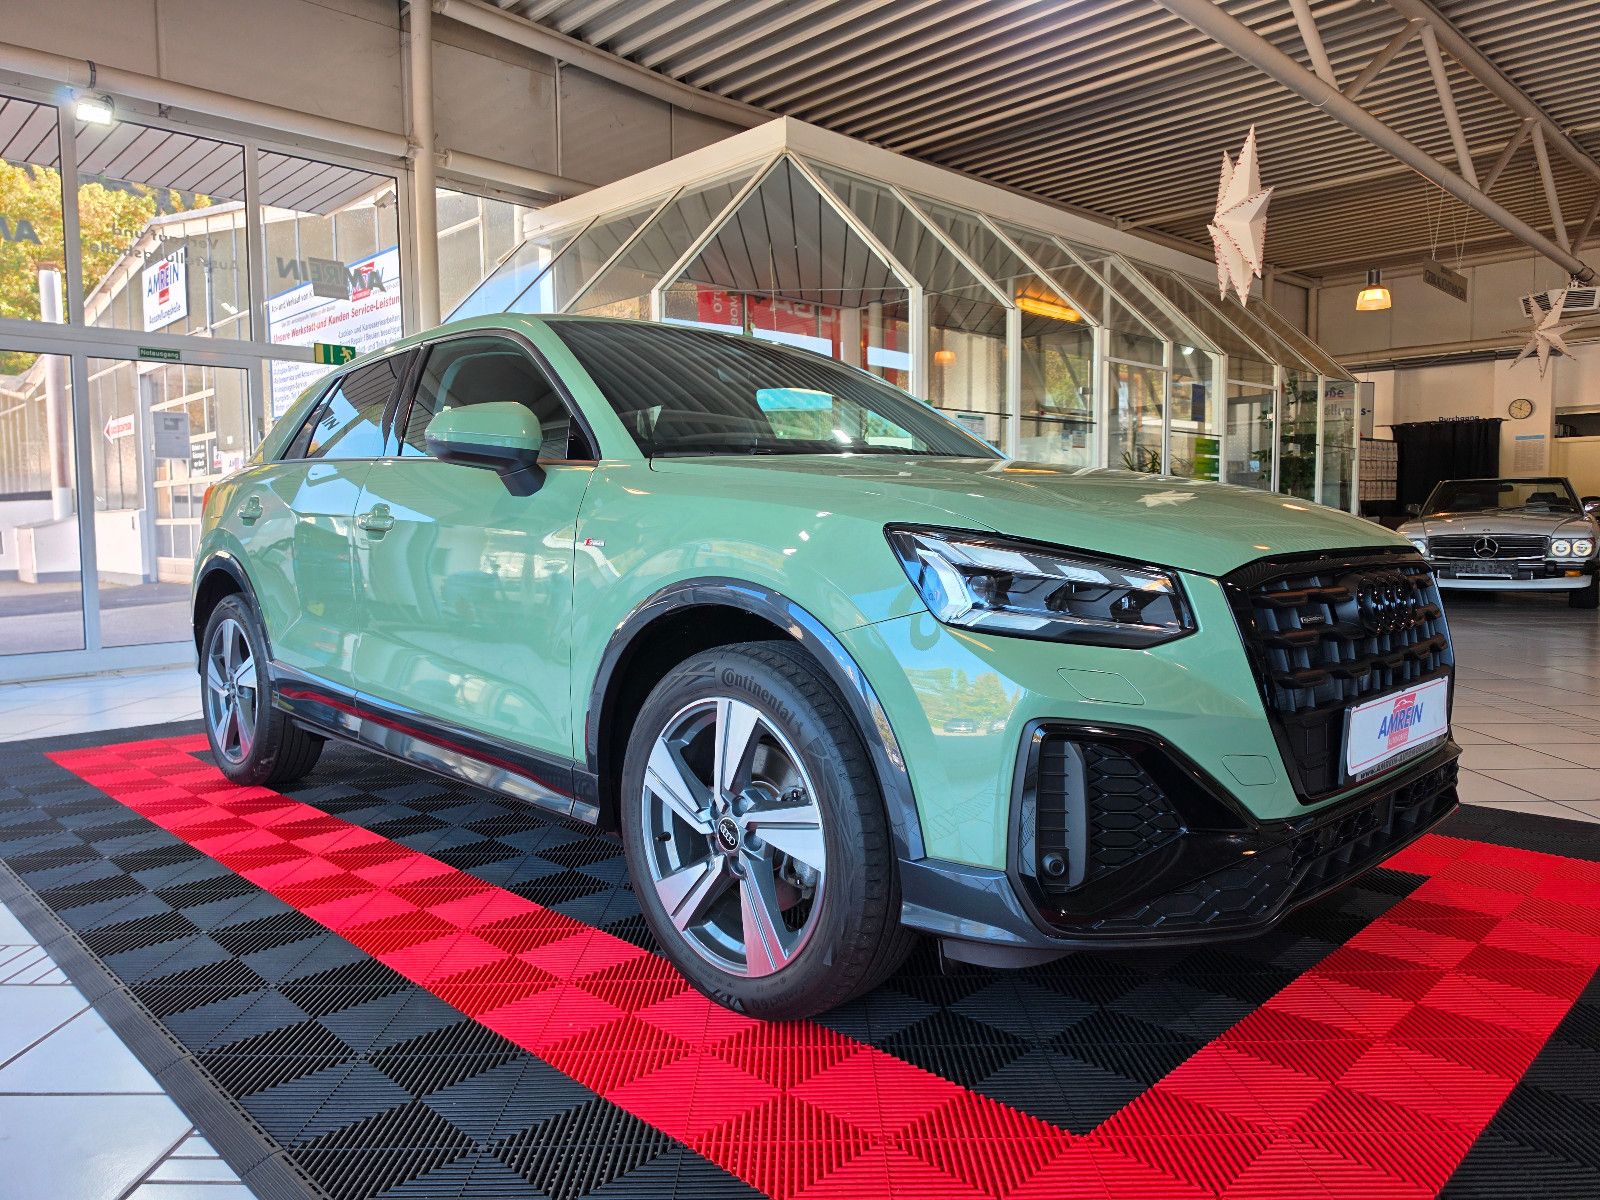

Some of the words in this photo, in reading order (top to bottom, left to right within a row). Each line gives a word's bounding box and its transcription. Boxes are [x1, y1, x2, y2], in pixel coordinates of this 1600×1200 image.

[147, 263, 180, 298] AMREIN
[328, 309, 350, 326] Kunden
[140, 350, 180, 359] Notausgang
[721, 667, 797, 726] Continental
[1377, 702, 1424, 739] AMREIN
